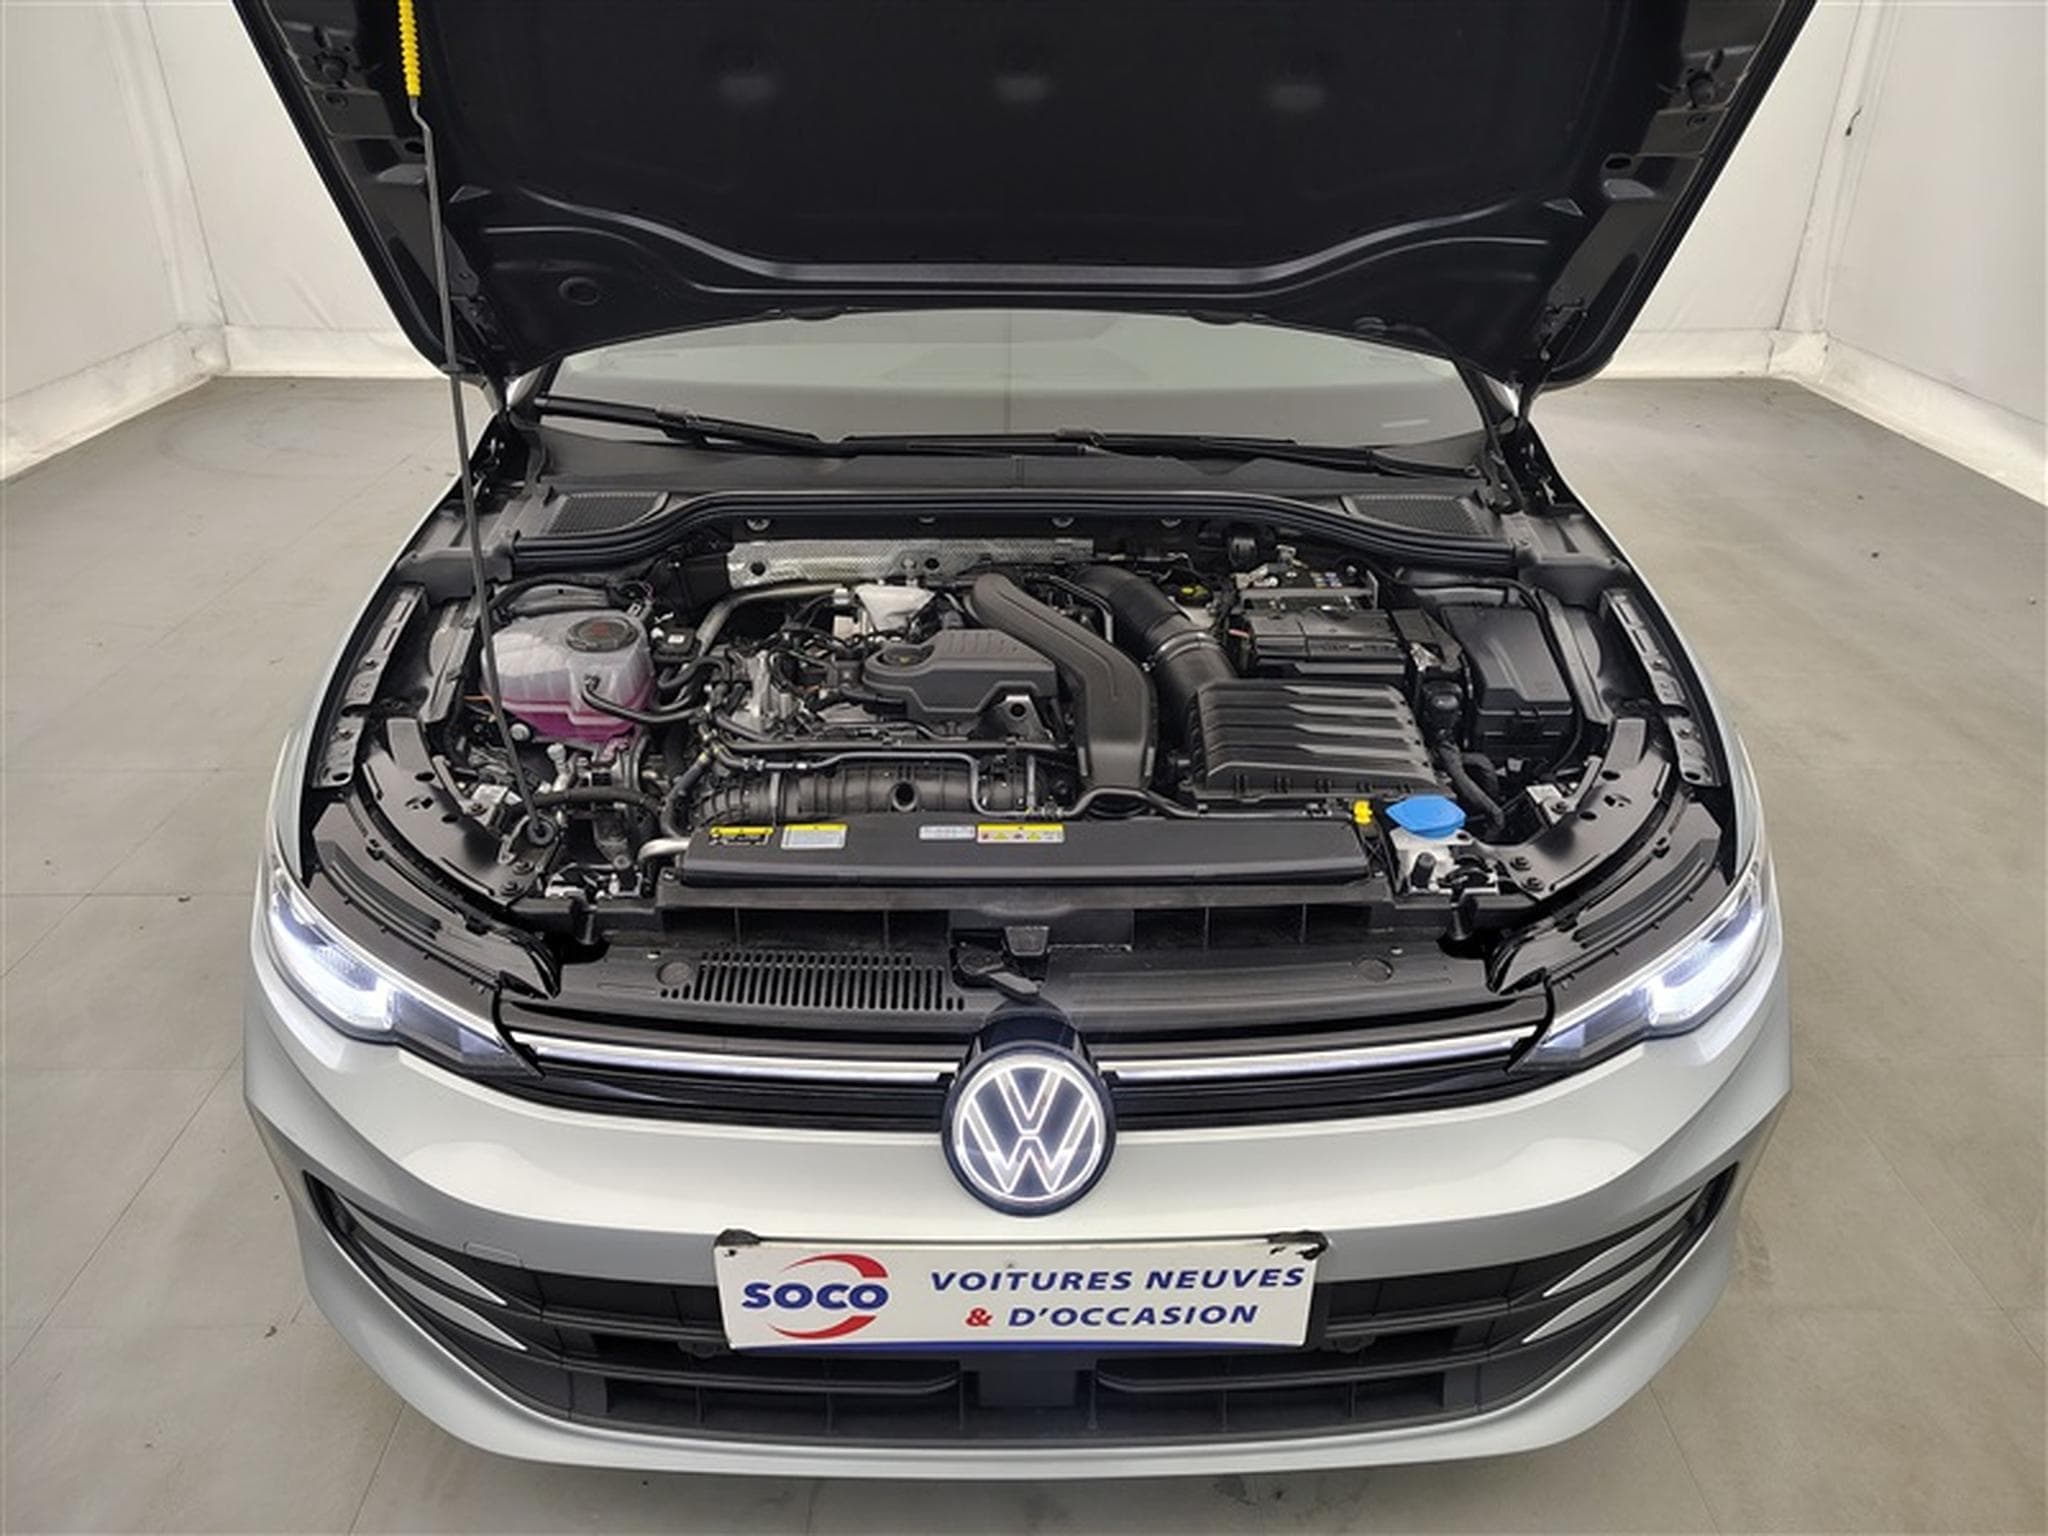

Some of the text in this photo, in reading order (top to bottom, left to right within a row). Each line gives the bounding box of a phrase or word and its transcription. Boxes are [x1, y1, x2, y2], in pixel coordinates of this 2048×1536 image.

[931, 1267, 1306, 1292] VOITURES NEUVES
[741, 1281, 889, 1311] SOCO
[965, 1304, 1258, 1328] & D'OCCASION
